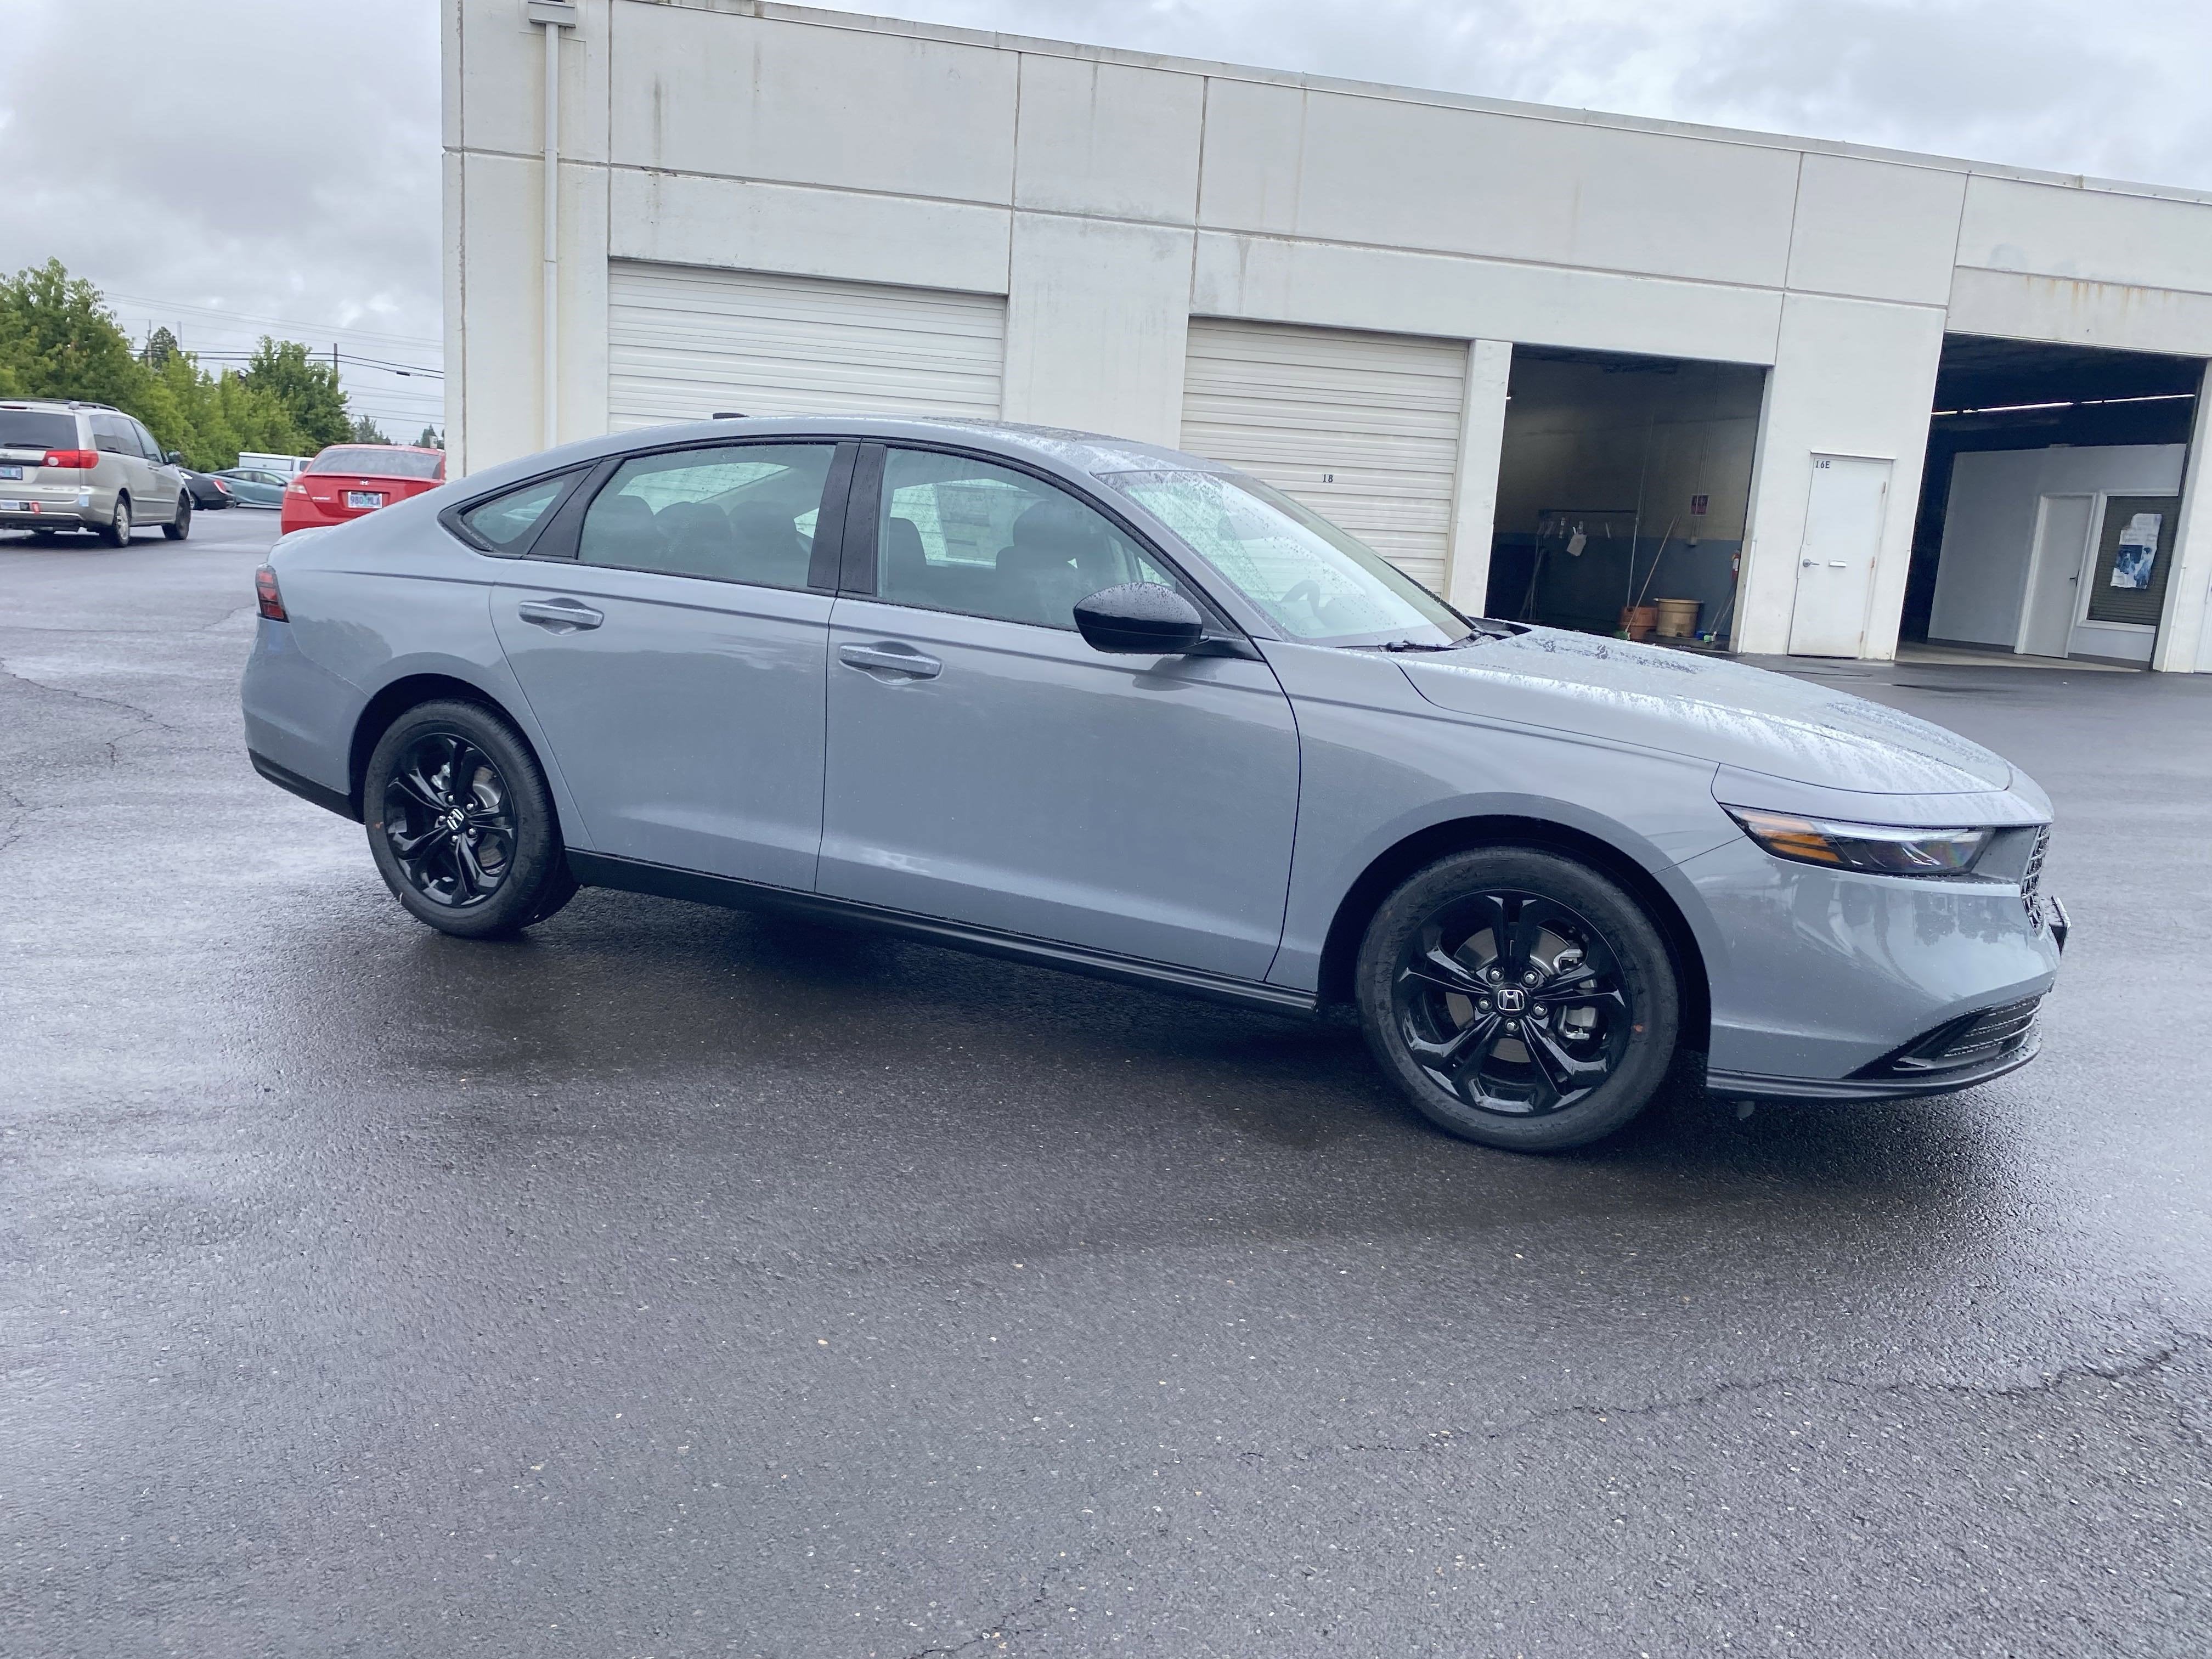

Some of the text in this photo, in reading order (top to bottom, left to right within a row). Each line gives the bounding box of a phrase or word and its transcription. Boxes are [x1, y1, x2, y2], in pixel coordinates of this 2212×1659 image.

[1815, 460, 1830, 469] 16E
[1323, 474, 1333, 483] 18
[350, 496, 363, 505] 980
